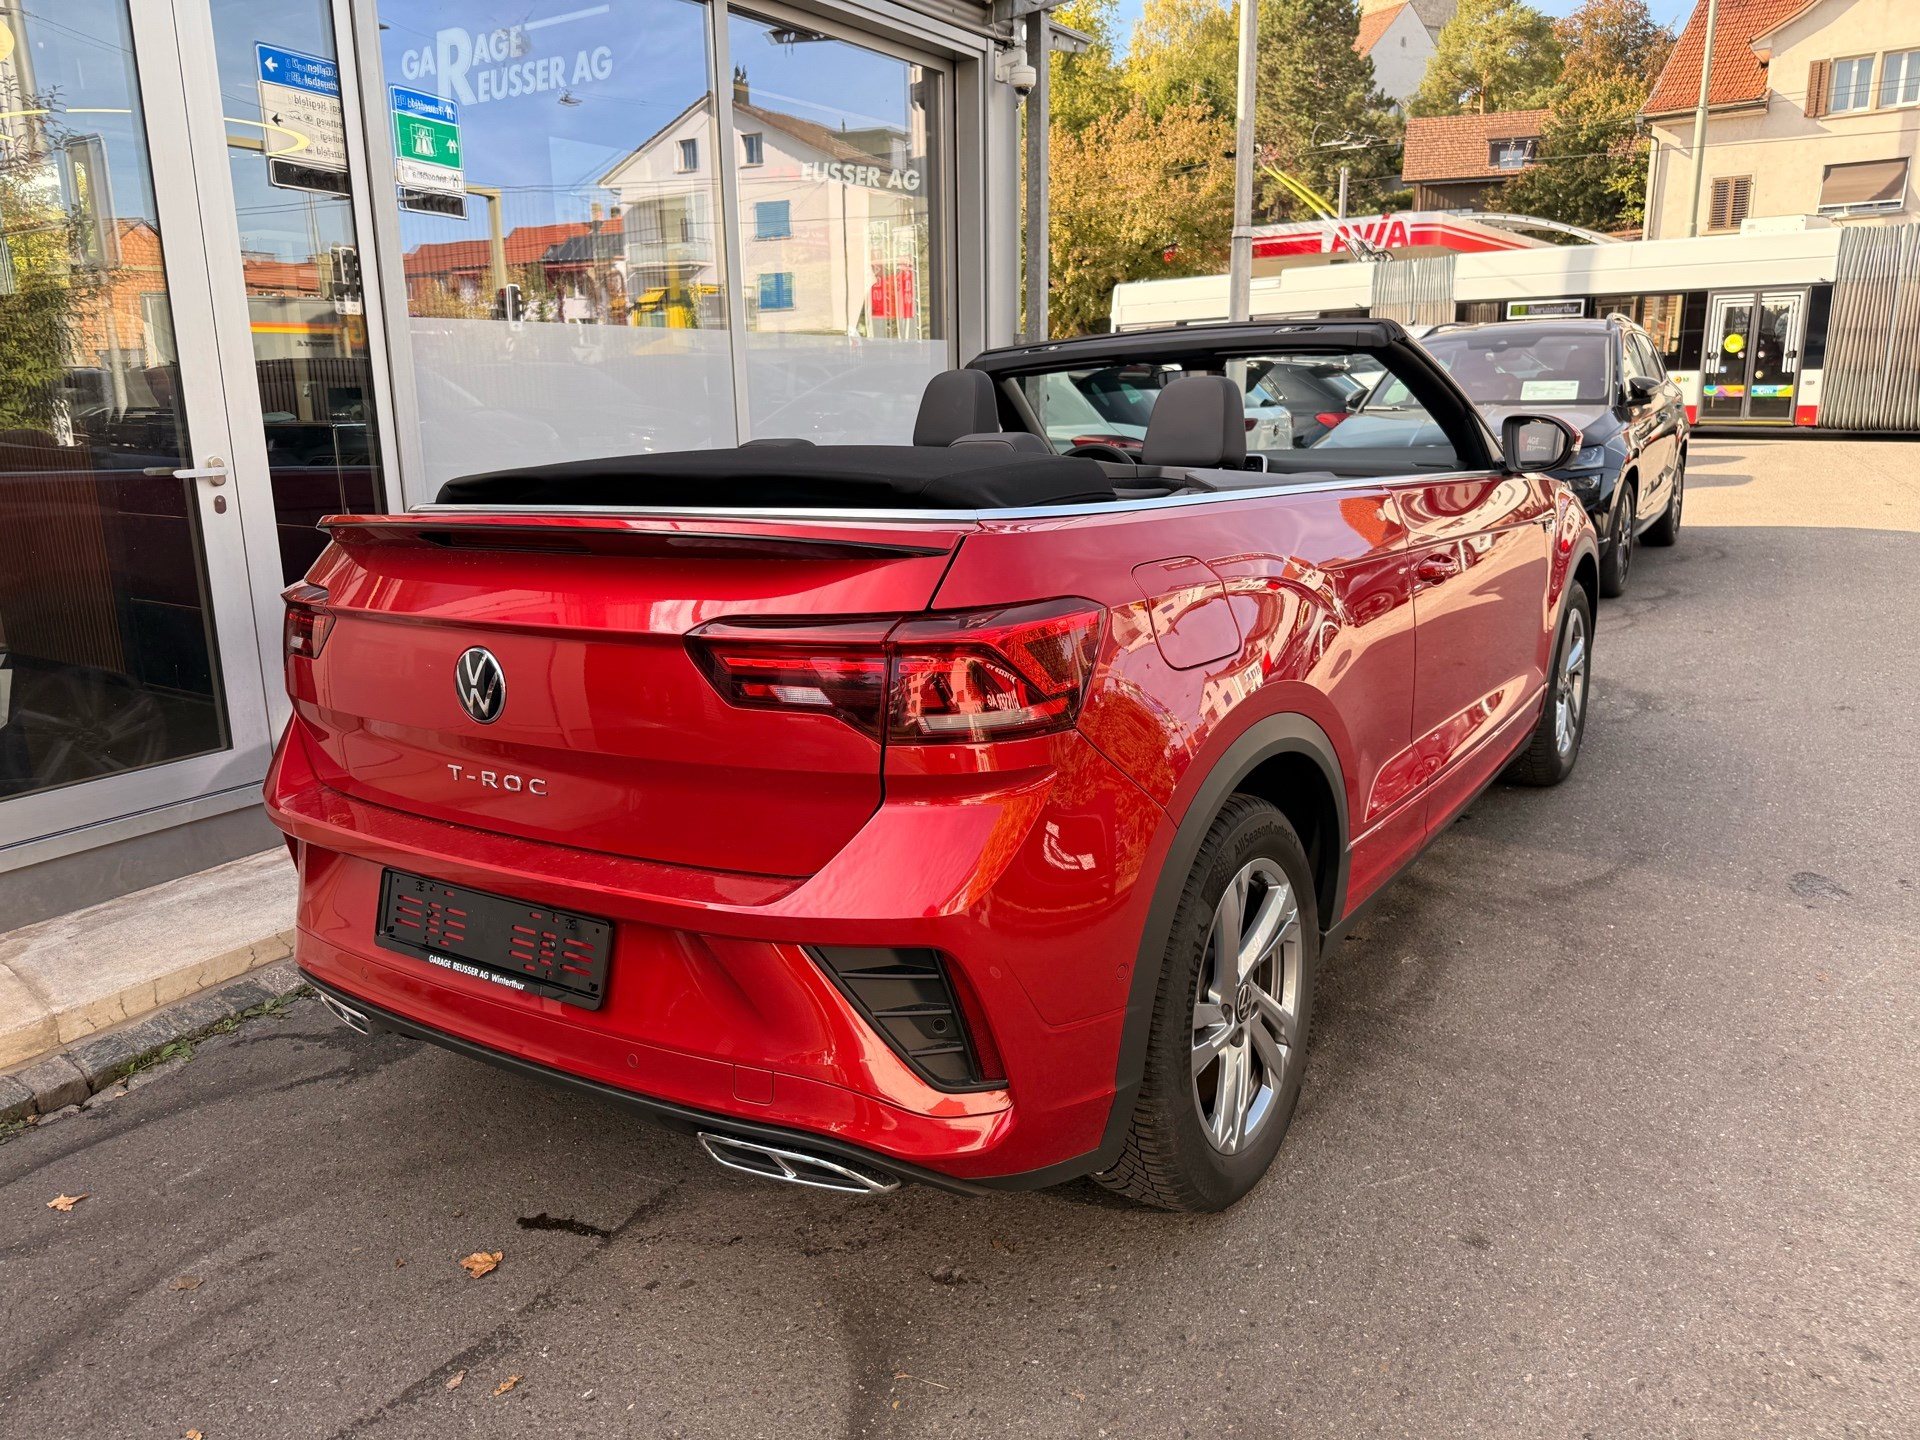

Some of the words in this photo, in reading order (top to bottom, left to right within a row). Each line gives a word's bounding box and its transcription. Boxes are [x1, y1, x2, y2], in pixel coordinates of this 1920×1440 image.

[572, 46, 613, 85] AG
[886, 168, 920, 191] AG
[1331, 212, 1408, 252] AVIA
[447, 764, 548, 796] T-ROC
[428, 954, 451, 969] GARAGE
[452, 961, 479, 977] REUSSER
[479, 970, 489, 980] AG
[491, 973, 525, 991] Winterthur
